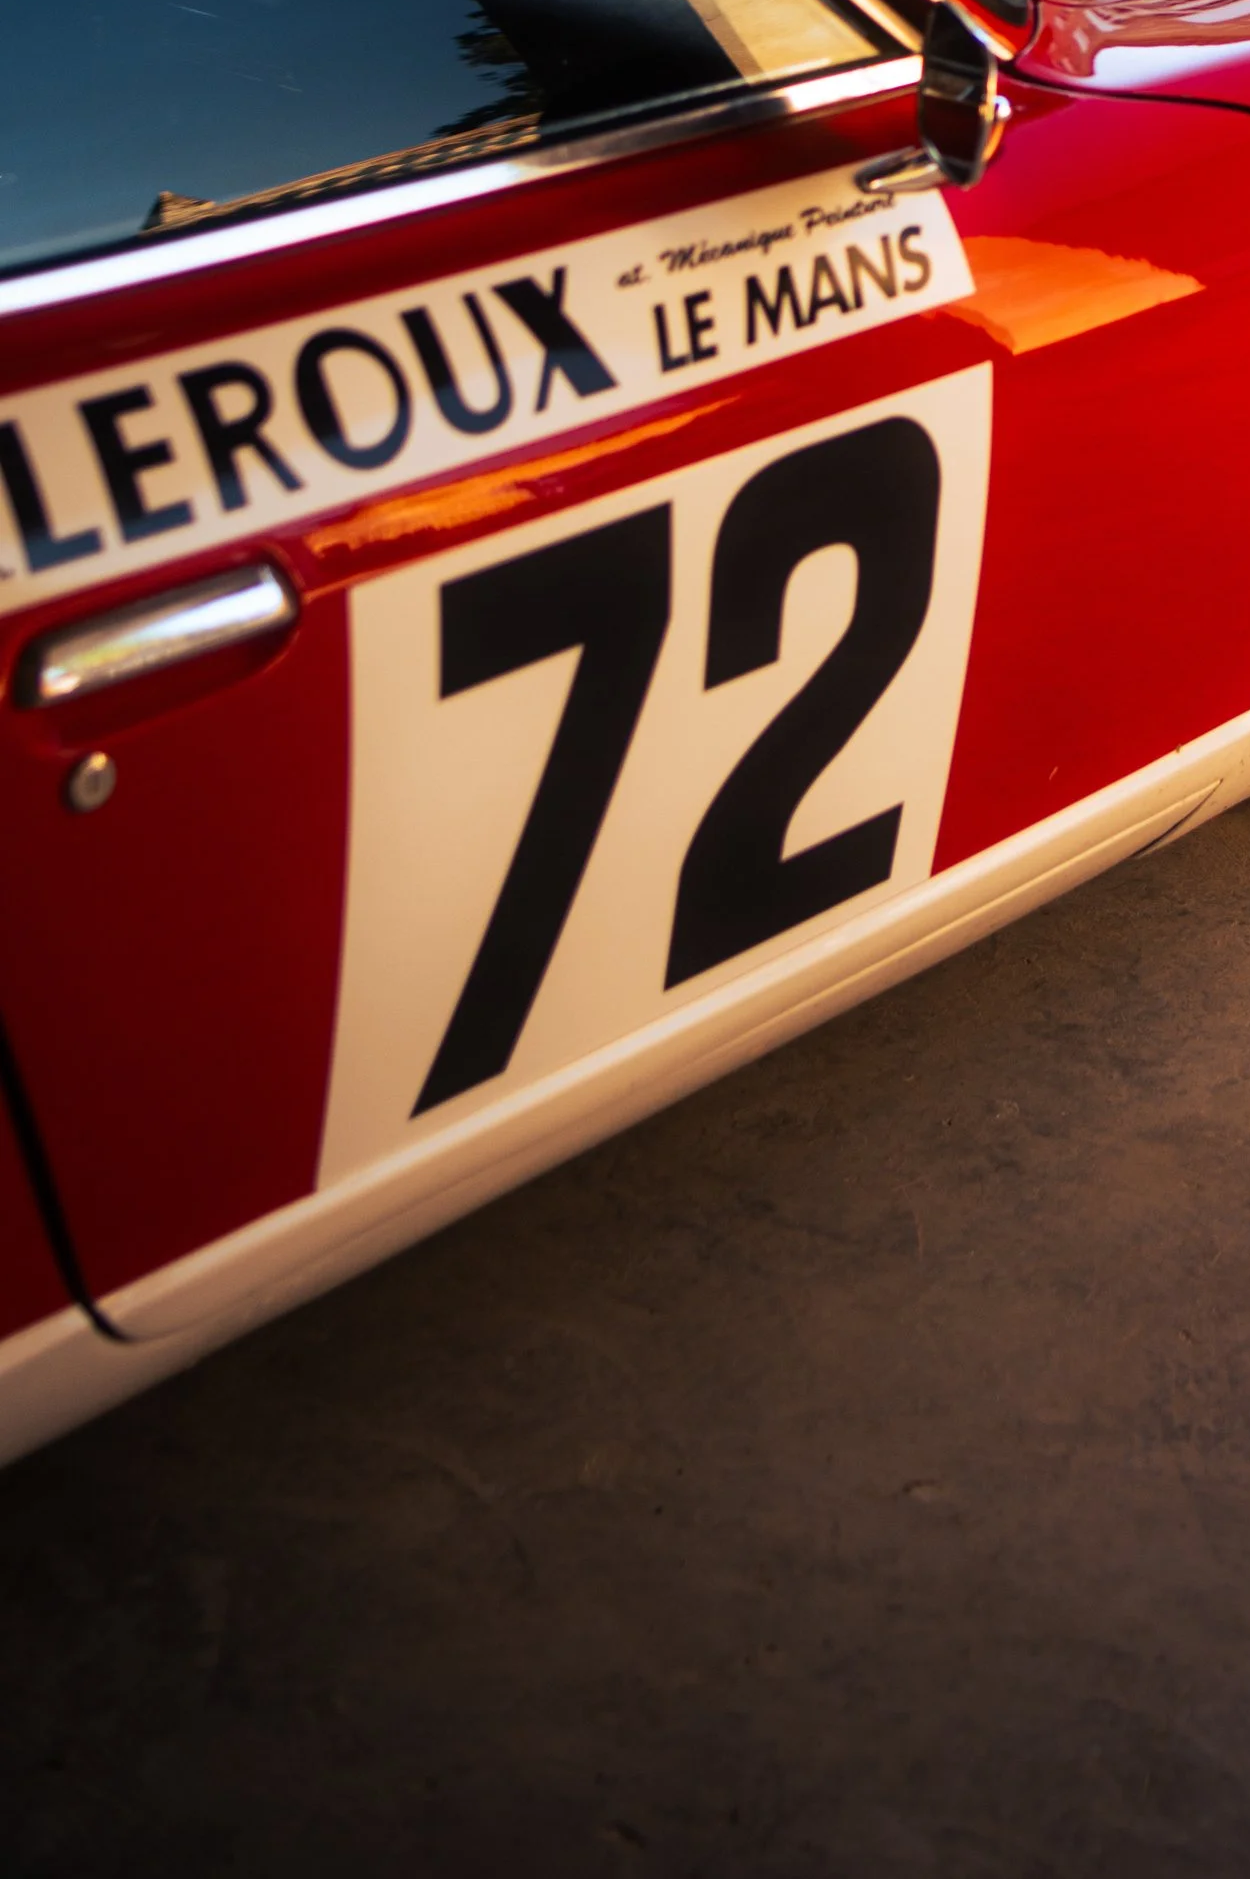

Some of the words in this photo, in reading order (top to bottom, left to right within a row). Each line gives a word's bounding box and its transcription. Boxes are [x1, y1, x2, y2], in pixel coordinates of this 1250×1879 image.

[0, 266, 617, 581] LEROUX
[654, 289, 718, 374] LE
[745, 225, 932, 347] MANS
[410, 415, 942, 1120] 72
